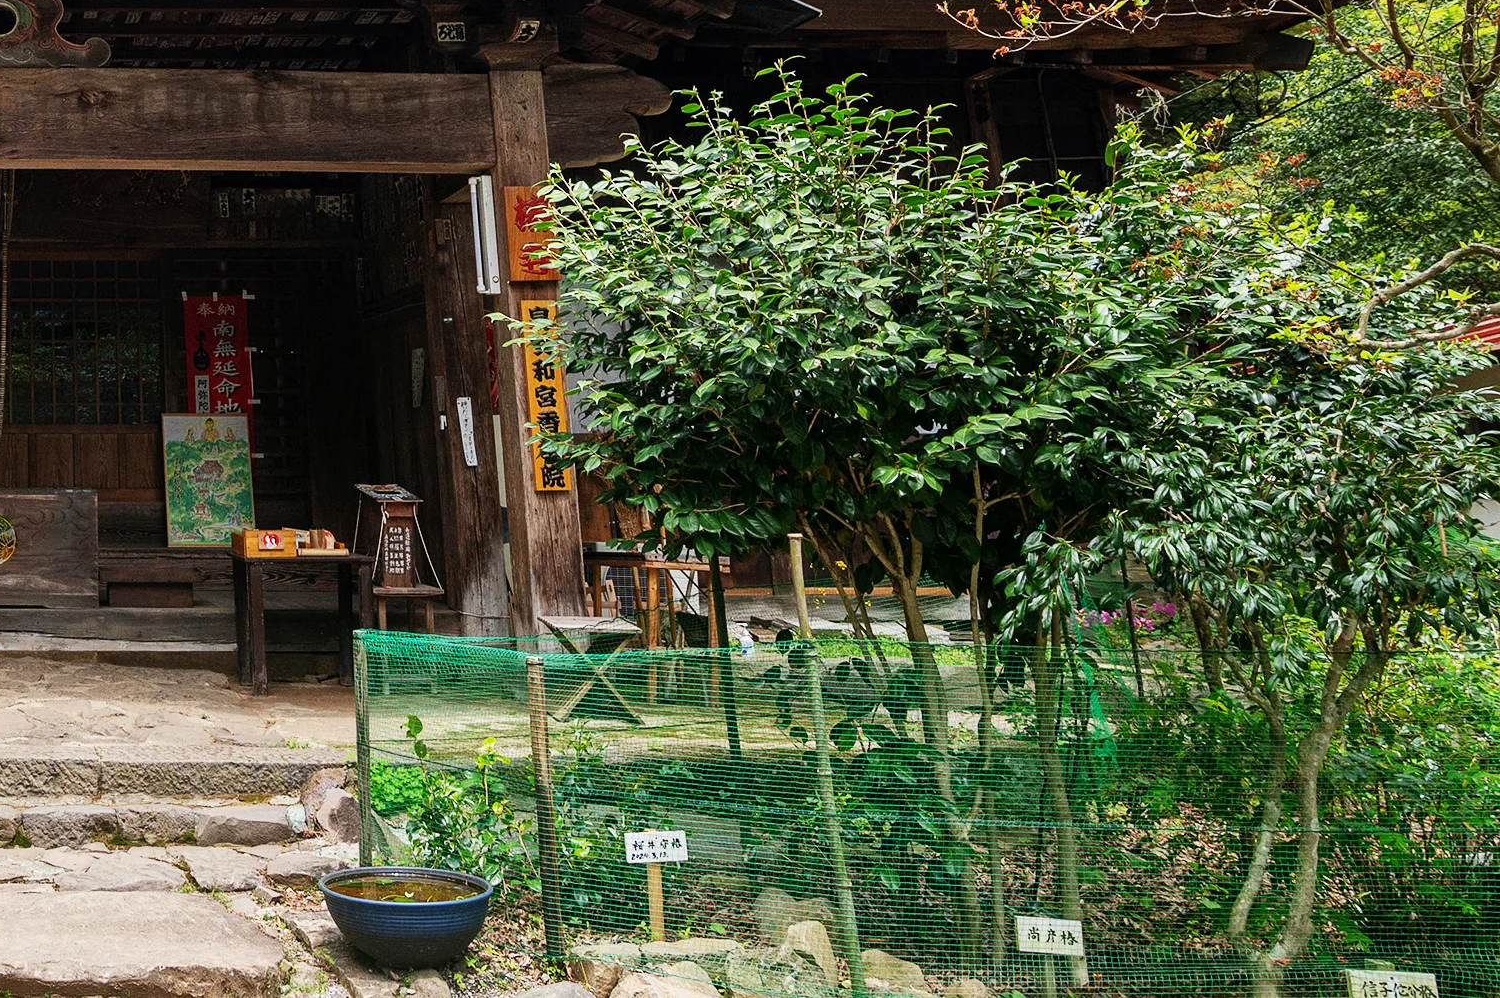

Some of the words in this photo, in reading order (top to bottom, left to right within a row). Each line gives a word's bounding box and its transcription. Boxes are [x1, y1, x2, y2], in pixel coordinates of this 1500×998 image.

[196, 302, 236, 318] 奉納
[197, 378, 209, 414] 阿弥陀
